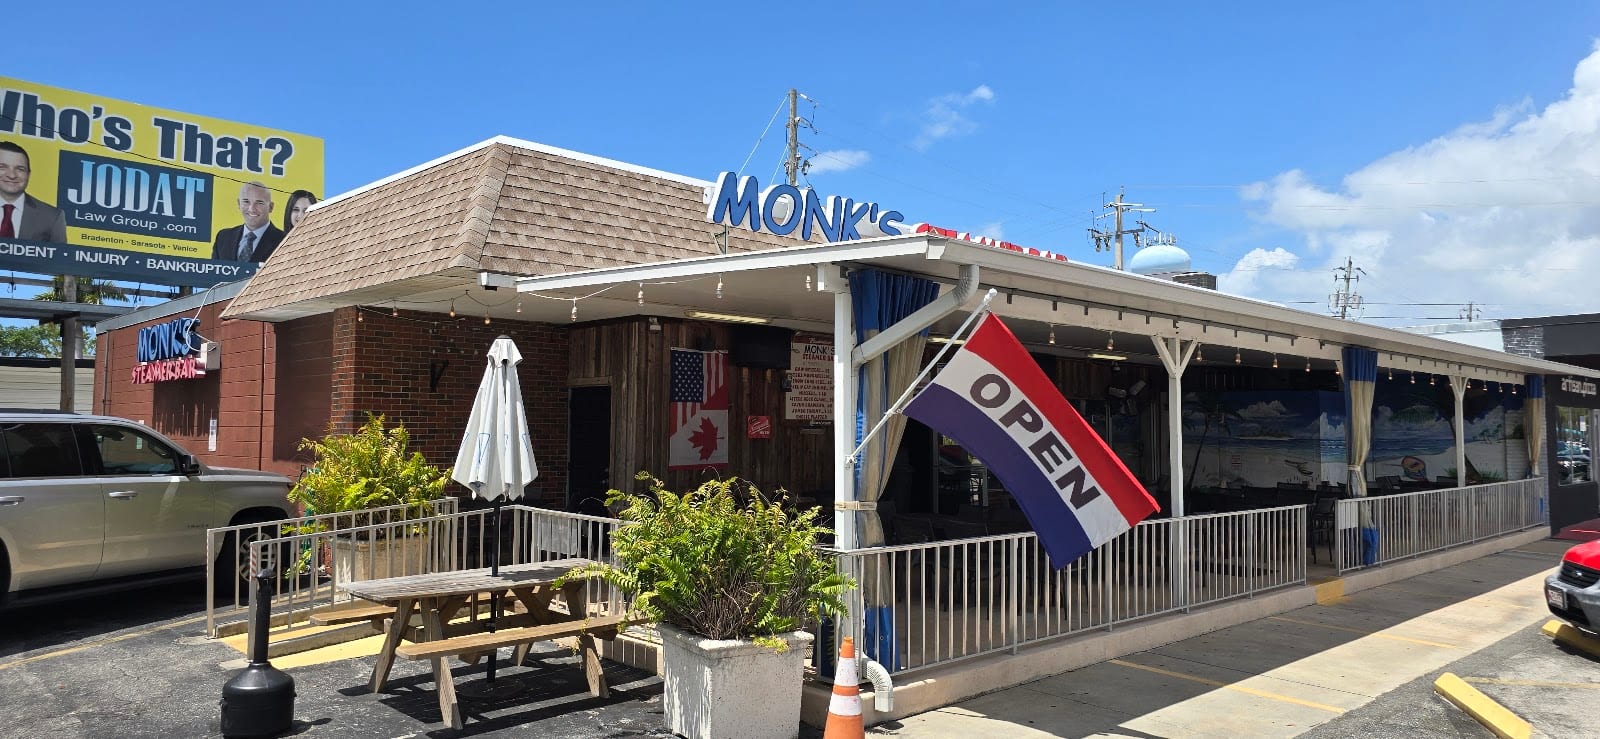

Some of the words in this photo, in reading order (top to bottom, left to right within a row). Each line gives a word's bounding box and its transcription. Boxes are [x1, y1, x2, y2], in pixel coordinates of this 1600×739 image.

[153, 117, 294, 176] That?
[67, 160, 205, 220] JODAT
[709, 171, 905, 243] MONK'S
[75, 209, 107, 222] Law
[111, 214, 158, 231] Group
[163, 222, 197, 234] .com
[75, 250, 130, 266] INJURY
[146, 258, 240, 276] BANKRUPTCY
[81, 233, 124, 244] Bradenton
[131, 239, 166, 250] Sarasota
[172, 244, 198, 253] Venice
[132, 360, 175, 385] STEAMER
[970, 373, 1102, 510] OPEN
